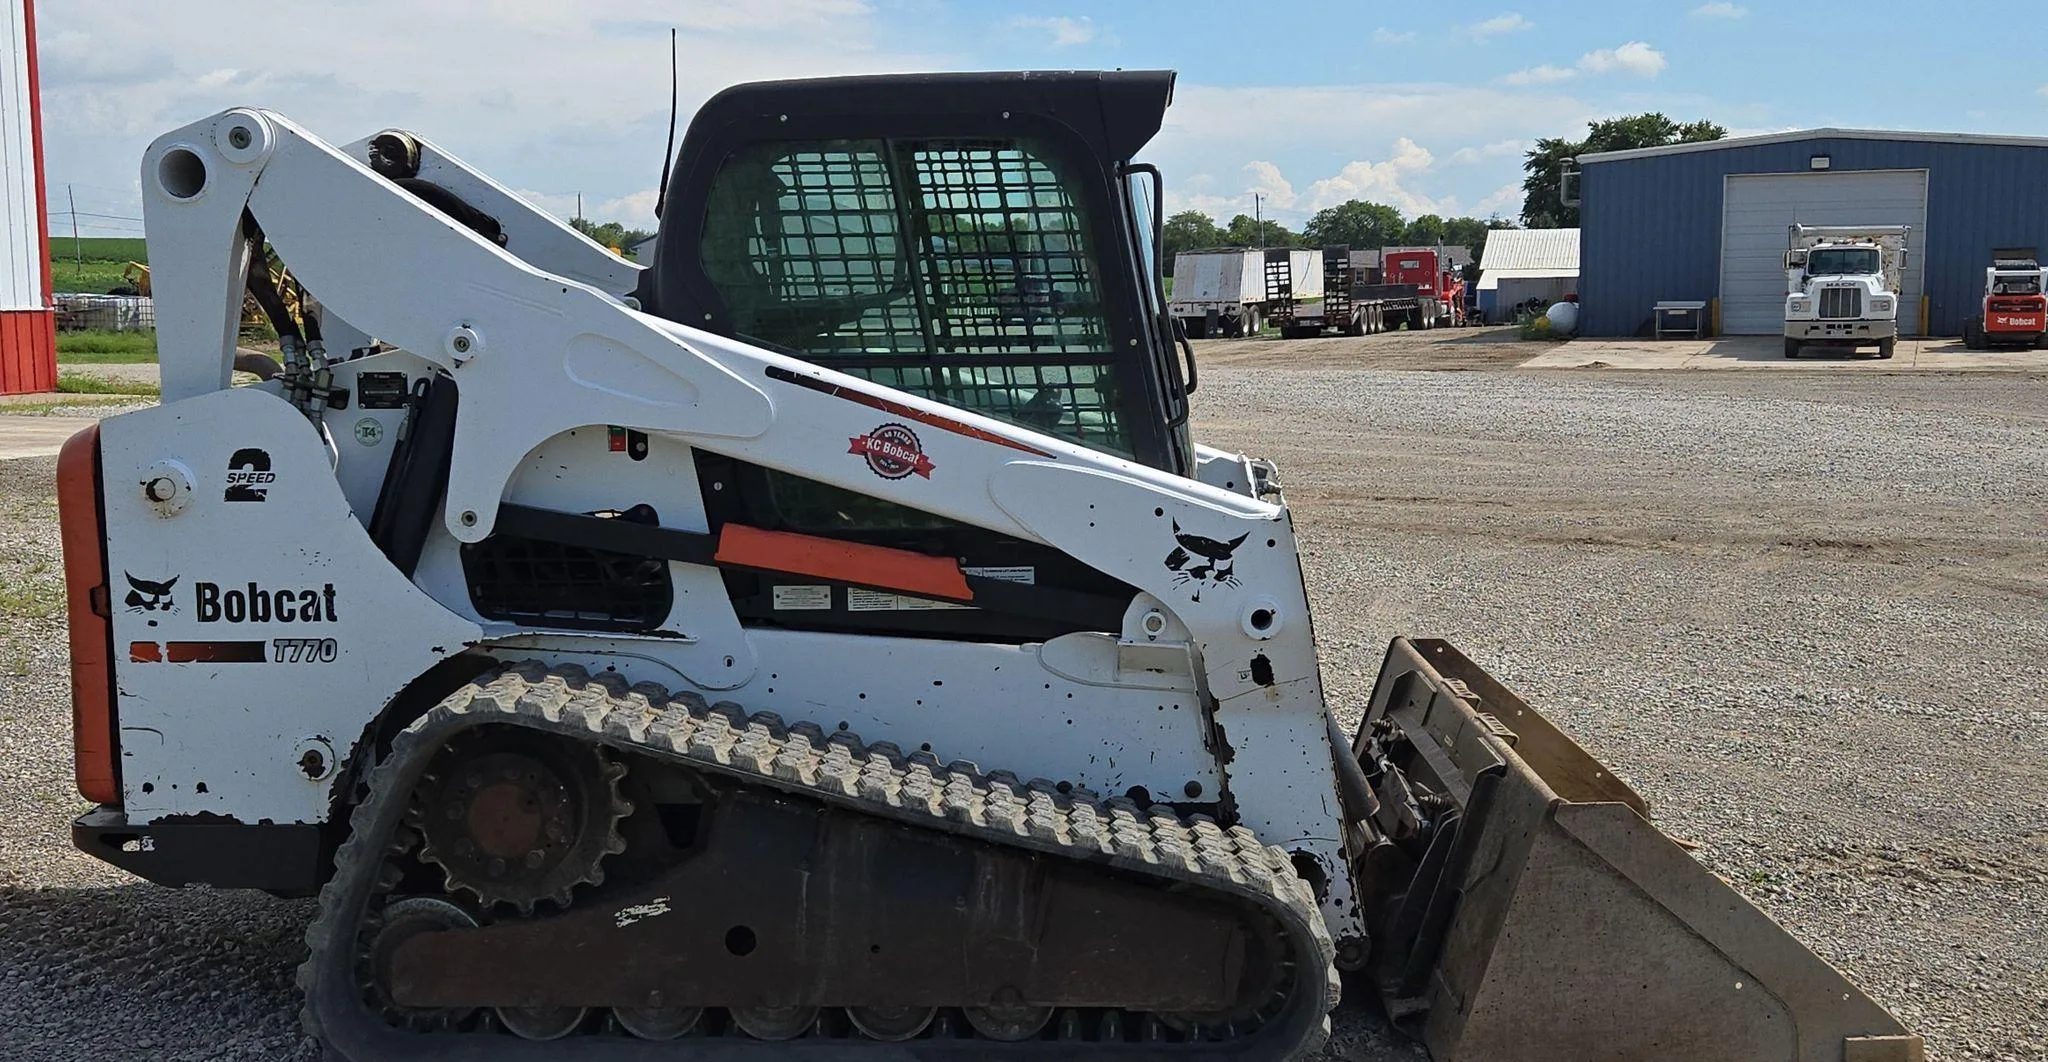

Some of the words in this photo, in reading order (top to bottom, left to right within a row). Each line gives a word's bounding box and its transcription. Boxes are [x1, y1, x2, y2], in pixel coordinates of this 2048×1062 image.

[2009, 317, 2036, 326] Bobcat
[893, 430, 912, 445] YEARS
[866, 437, 882, 451] KC
[883, 442, 920, 465] Bobcat
[224, 448, 272, 503] 2
[226, 472, 276, 484] SPEED
[195, 582, 338, 623] Bobcat
[273, 638, 338, 663] T770
